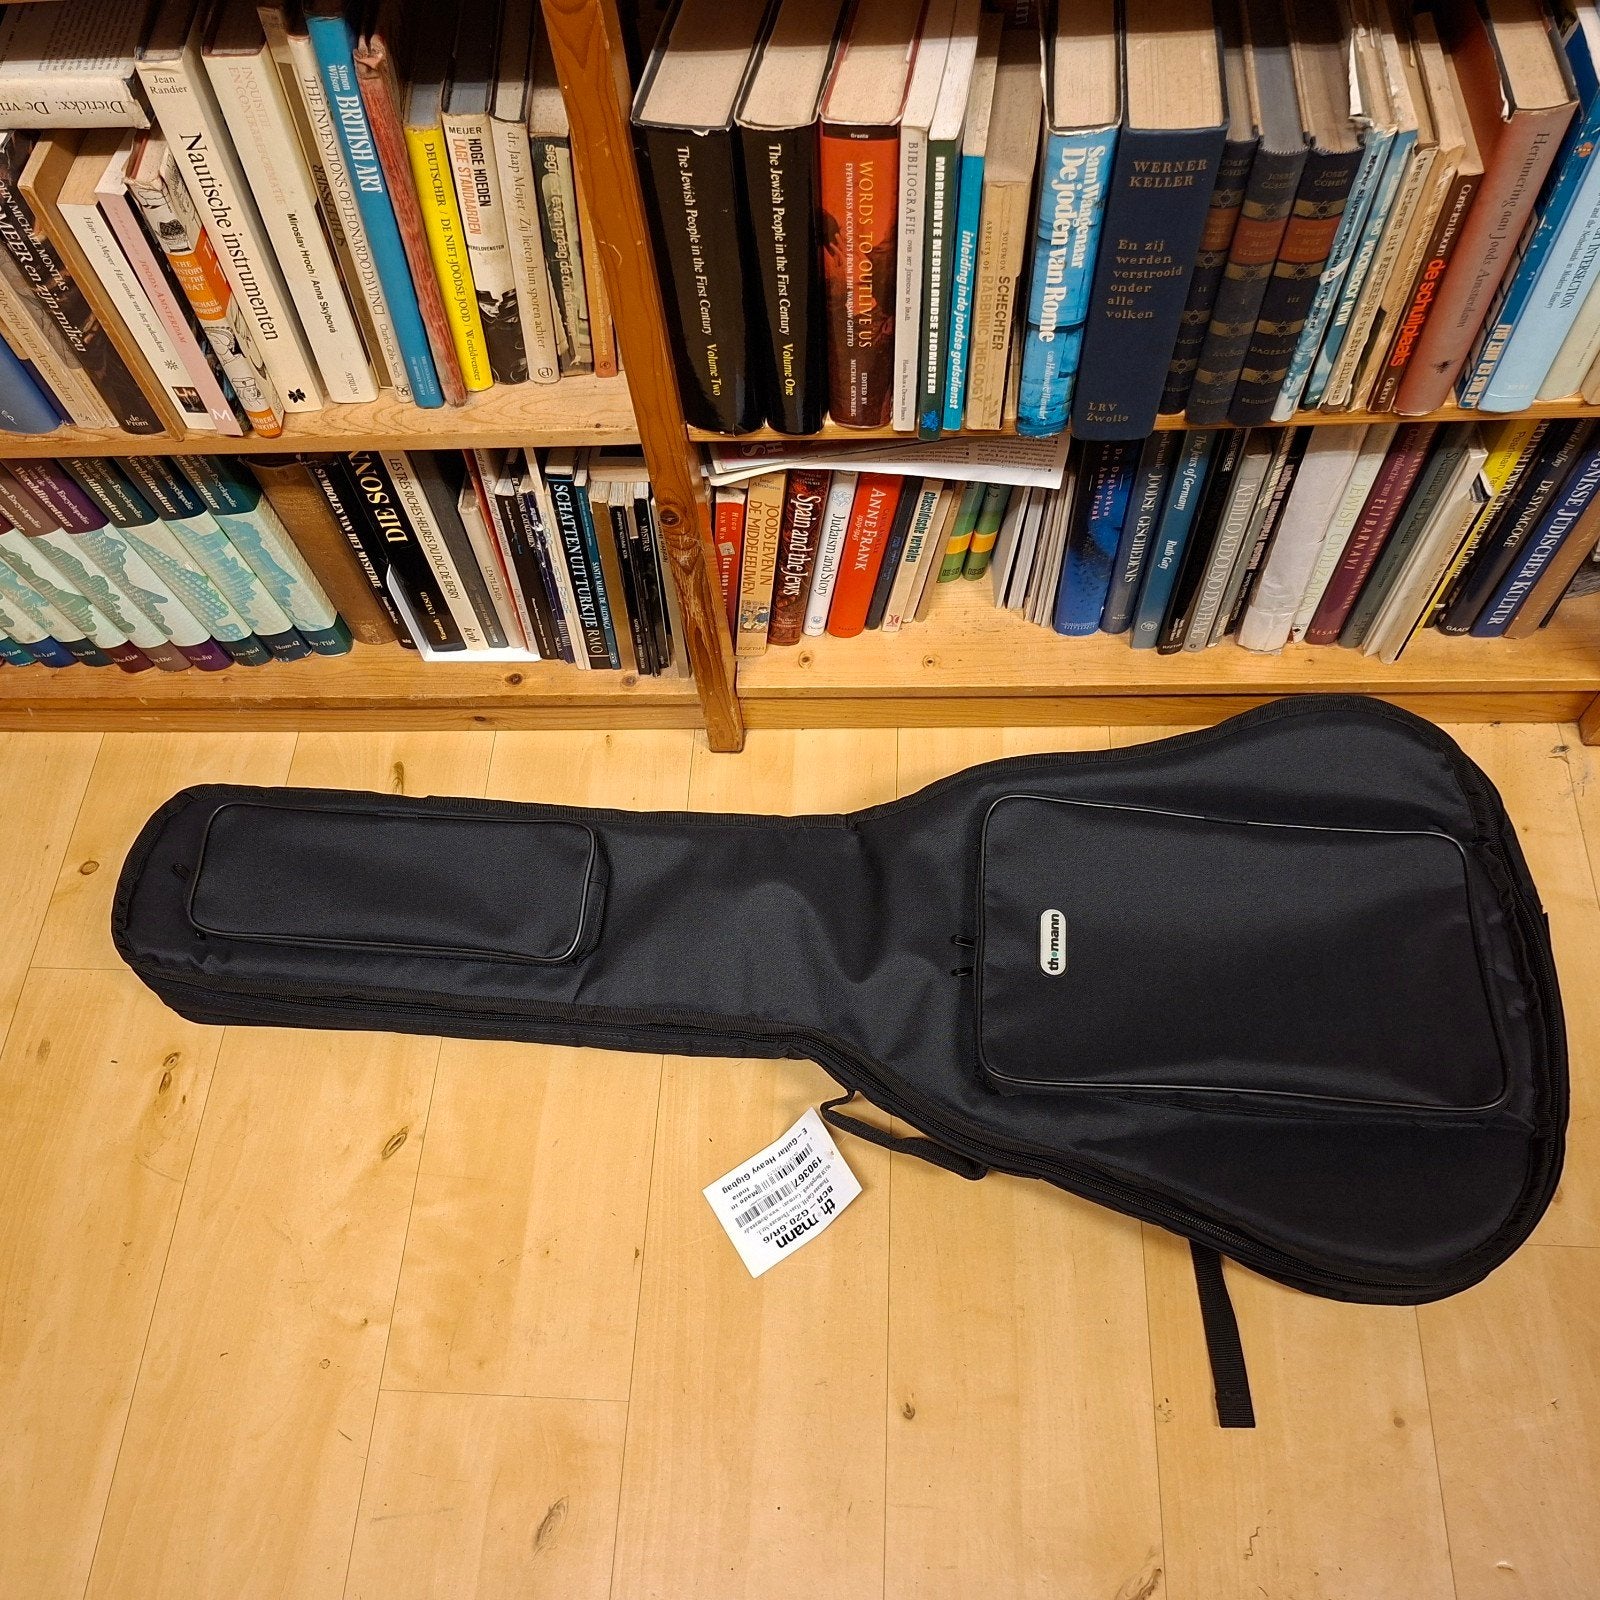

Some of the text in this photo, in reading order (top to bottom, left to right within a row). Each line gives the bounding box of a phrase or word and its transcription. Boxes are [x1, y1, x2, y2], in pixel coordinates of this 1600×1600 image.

[150, 86, 188, 94] Randier
[154, 75, 176, 83] Jean
[304, 76, 324, 105] THE
[328, 65, 341, 92] Wilson
[337, 65, 351, 91] Simon
[25, 101, 127, 114] Dierickx: De
[449, 126, 482, 135] MEIJER
[336, 95, 382, 193] BRITISH ART
[1060, 147, 1087, 181] De
[1133, 160, 1209, 174] WERNER
[453, 138, 482, 235] LAGE STANDAARDEN
[468, 138, 491, 208] HOGE HOEDEN
[905, 142, 919, 235] BIBLIOGRAFIE
[1129, 176, 1194, 188] KELLER
[1482, 132, 1549, 265] Herinnering aan Joods
[1051, 179, 1082, 246] joden
[1071, 145, 1106, 268] Sam Waagenaar
[9, 204, 69, 292] MICHAEL MONTIAS
[178, 132, 279, 340] Nautische instrumenten
[286, 212, 324, 300] Miroslav Hroch Anna
[507, 151, 542, 319] Jaap lieten hun sporen
[554, 228, 570, 258] praag
[845, 162, 853, 346] EYEWITNESS ACCOUNTS FROM THE WARSAW GHETTO
[858, 161, 874, 348] WORDS TO OUTLIVE US
[1116, 256, 1173, 265] werden
[1117, 241, 1164, 252] En zij
[424, 142, 481, 381] DEUTSCHER DE NIET-JOODSE JOOD Wereldvenster
[677, 146, 722, 396] The Jewish People in the First Century Volume Two
[768, 144, 796, 396] The Jewish People in the First Century Volume One
[927, 156, 945, 394] MARKANTE NEDERLANDSE ZIONISTEN
[1046, 249, 1067, 284] van
[1113, 268, 1182, 278] verstrooid
[1425, 259, 1446, 279] de
[1560, 244, 1600, 308] INTERSECTION
[25, 260, 86, 353] en zijn milieu
[977, 276, 994, 335] RABBINIC
[992, 232, 1010, 351] SOLOMON SCHECHTER
[1107, 297, 1134, 306] alle
[1110, 284, 1152, 293] onder
[157, 291, 187, 344] AMSTERDAM
[949, 230, 974, 409] inleiding de joodse godsdienst
[1039, 286, 1066, 343] Rome
[1105, 310, 1154, 319] volken
[1392, 281, 1434, 366] schuilplaats
[16, 466, 74, 528] Wereldliteratuur
[72, 460, 127, 523] Wereldliteratuur
[791, 493, 822, 526] Spain
[1091, 494, 1102, 520] Frank
[1103, 466, 1120, 516] Dagboeken
[1174, 468, 1198, 511] of Germany
[1339, 483, 1367, 528] JEWISH
[1503, 480, 1554, 548] DE SYNAGOGE
[374, 509, 408, 543] DIE
[390, 458, 460, 600] LES RICHES HEURES BERRY
[554, 484, 582, 556] SCHATTEN
[760, 503, 779, 586] JOODS LEVEN IN
[789, 528, 812, 552] and
[854, 488, 887, 571] ANNE FRANK
[905, 491, 936, 563] chassidische verhalen
[1125, 474, 1163, 583] JOODSE GESCHIEDENIS
[1344, 519, 1376, 570] BARNAVI
[1454, 459, 1526, 579] JEWRY History Culture
[358, 548, 382, 589] MYSTERIE
[570, 555, 586, 581] UIT
[592, 561, 600, 579] SANTA
[742, 500, 763, 600] DE MIDDELEEUWEN
[786, 552, 809, 570] the
[814, 513, 846, 596] Judaism and Story
[576, 581, 597, 629] TURKIJE
[780, 569, 808, 596] Jews
[1487, 581, 1532, 625] KULTUR
[722, 1174, 751, 1194] Gigbag
[752, 1156, 776, 1175] Heavy
[794, 1156, 822, 1188] 190367
[732, 1187, 749, 1200] India
